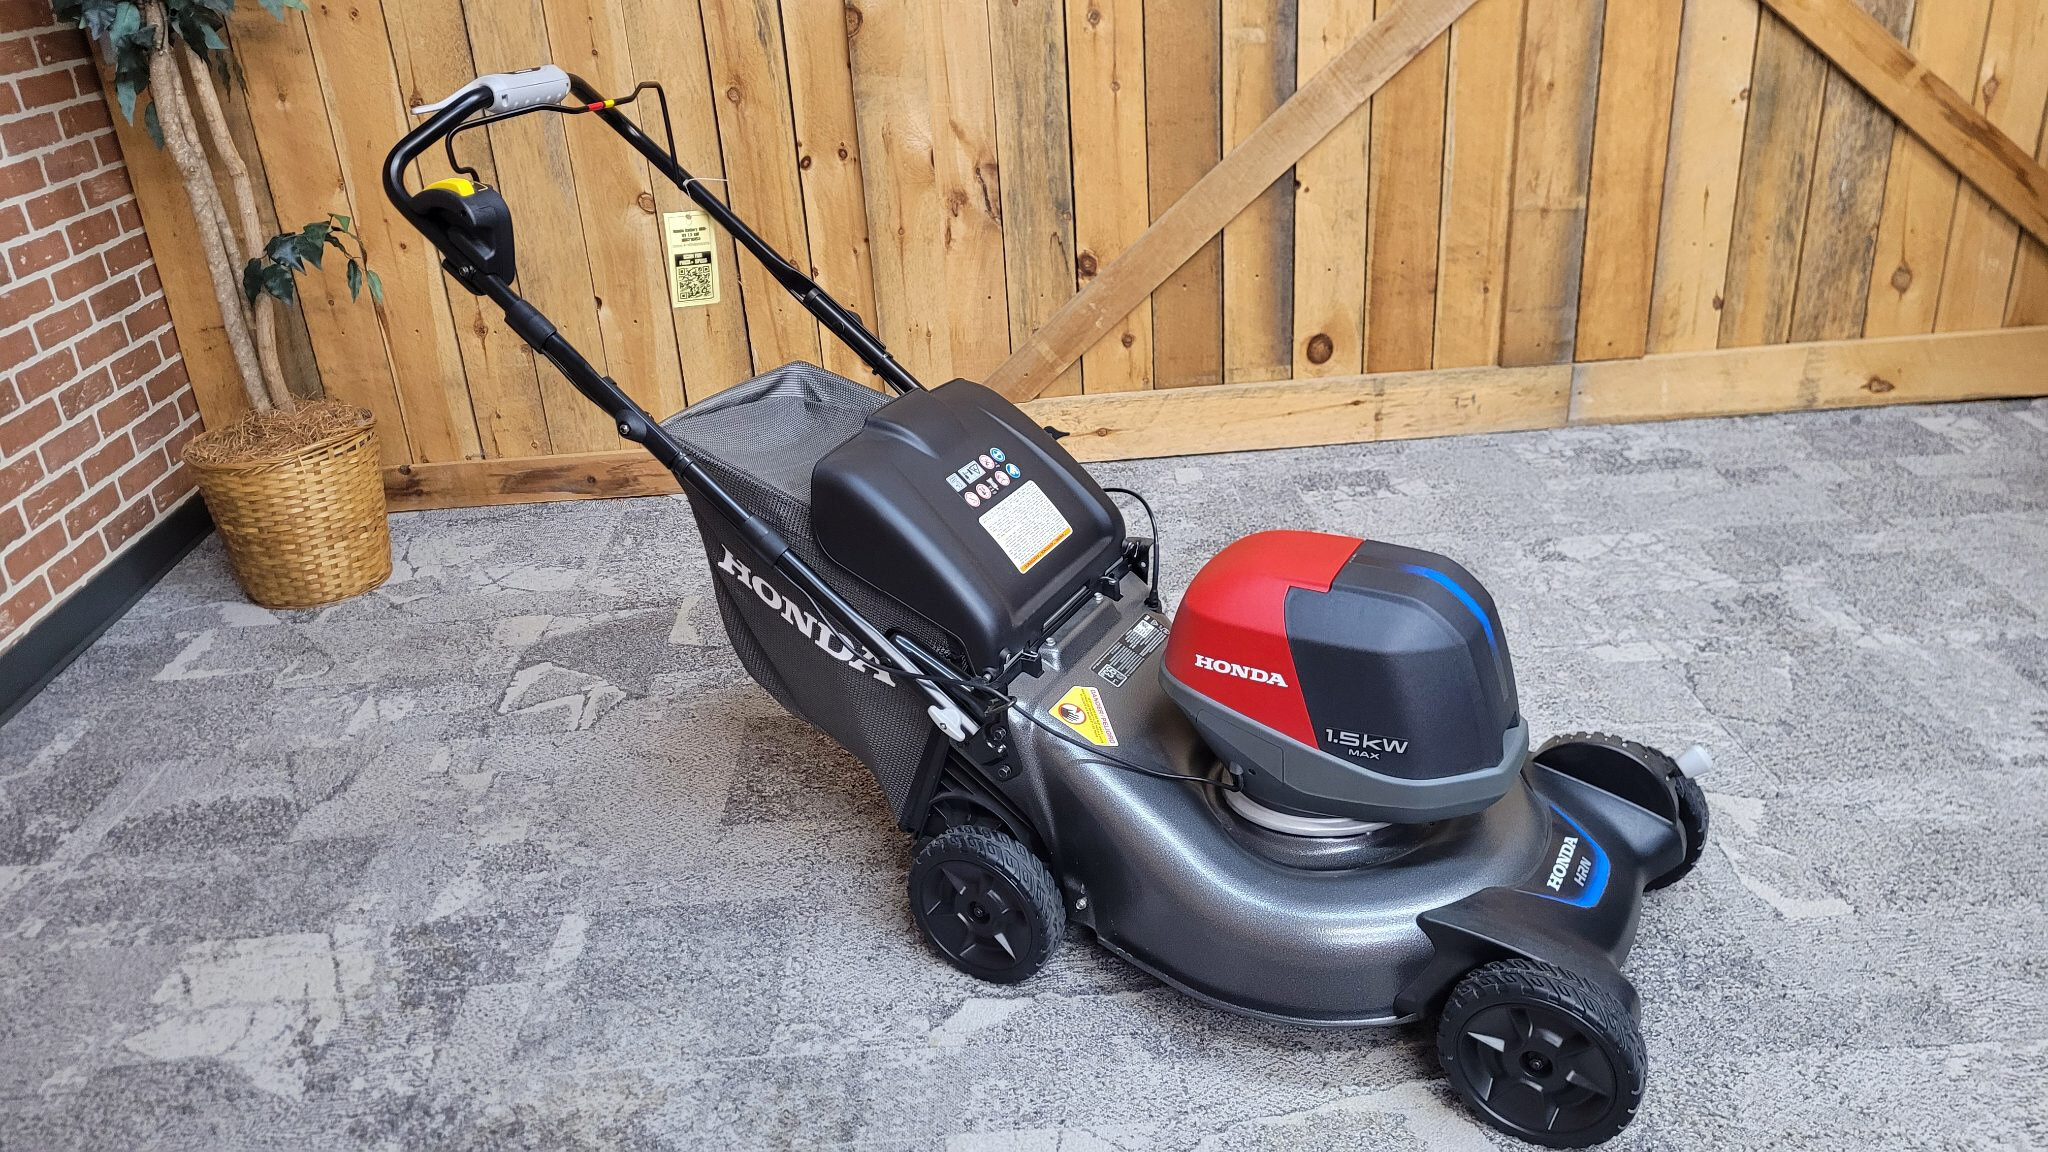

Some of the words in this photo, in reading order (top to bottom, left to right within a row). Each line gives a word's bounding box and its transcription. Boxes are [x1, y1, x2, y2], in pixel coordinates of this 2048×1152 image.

[1194, 653, 1289, 688] HONDA
[1348, 748, 1380, 760] MAX
[1546, 836, 1579, 892] HONDA
[1574, 856, 1592, 887] HRN
